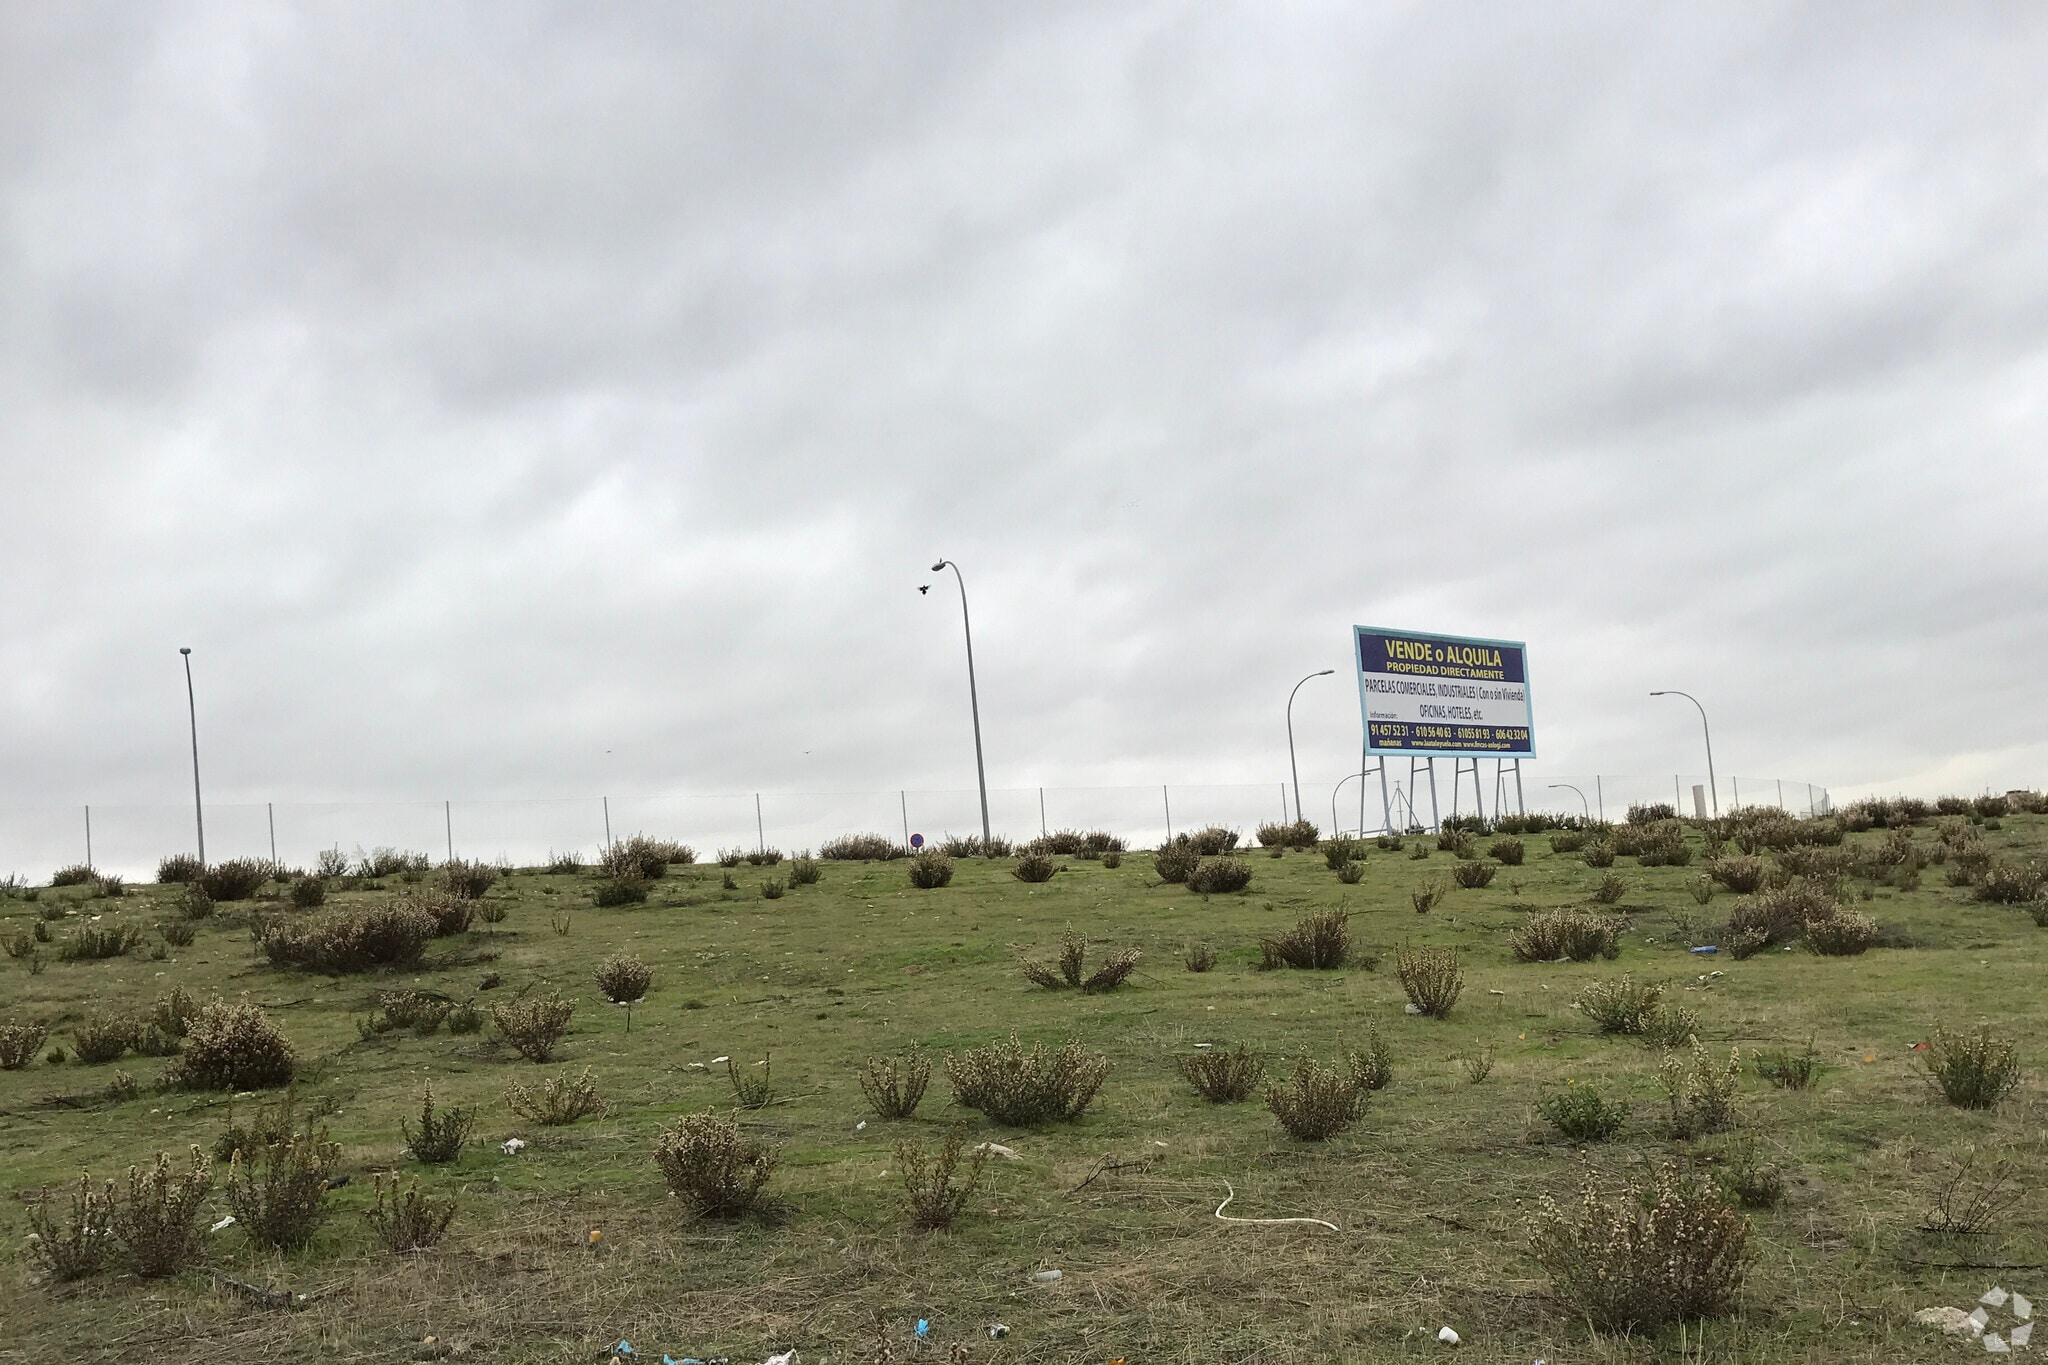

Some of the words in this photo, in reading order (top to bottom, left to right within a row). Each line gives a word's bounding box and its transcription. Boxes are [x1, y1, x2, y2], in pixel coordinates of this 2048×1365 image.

[1385, 639, 1433, 661] VENDE
[1435, 648, 1444, 662] o
[1447, 645, 1502, 667] ALQUILA
[1386, 661, 1439, 675] PROPIEDAD
[1440, 666, 1504, 680] DIRECTAMENTE
[1365, 679, 1396, 694] PARCELAS
[1396, 681, 1438, 698] COMERCIALES,
[1438, 684, 1476, 699] INDUSTRIALES
[1419, 704, 1448, 720] OFICINAS,
[1447, 706, 1474, 721] HOTELES,
[1371, 724, 1379, 736] 91
[1380, 724, 1392, 736] 457
[1393, 725, 1401, 736] 52
[1401, 725, 1409, 737] 31
[1415, 726, 1428, 737] 610
